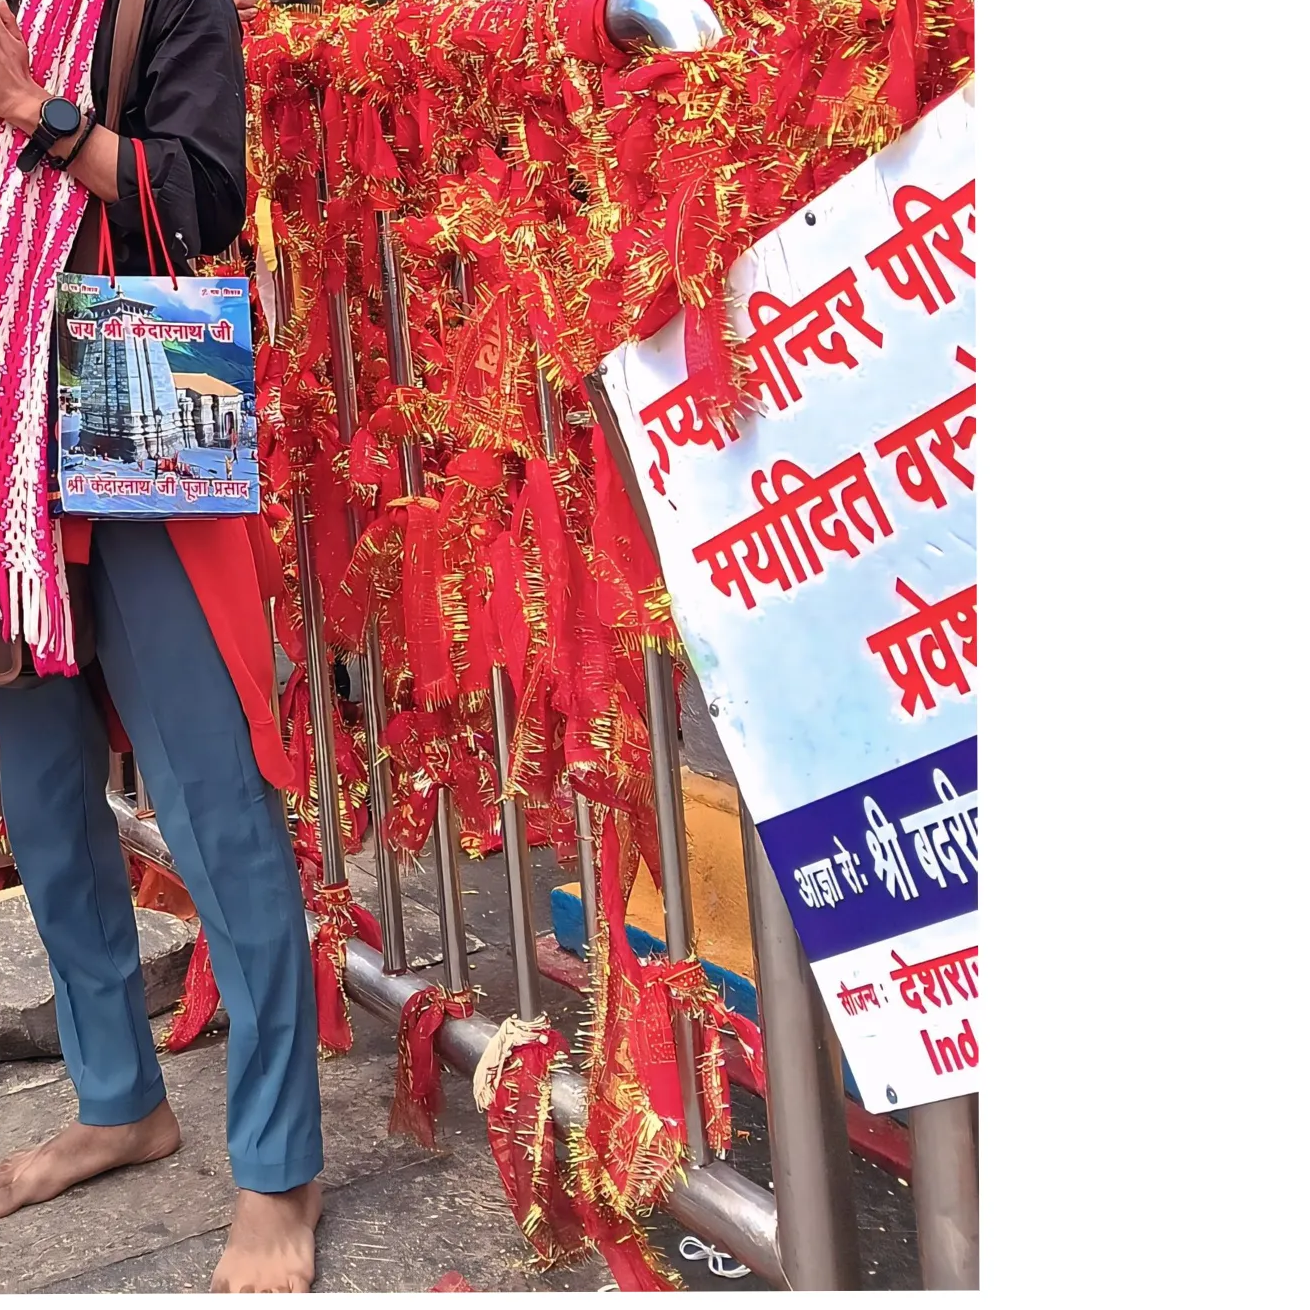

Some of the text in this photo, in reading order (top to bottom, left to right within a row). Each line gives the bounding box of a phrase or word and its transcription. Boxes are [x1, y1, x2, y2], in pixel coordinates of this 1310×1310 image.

[865, 178, 976, 316] परि
[69, 317, 233, 342] जय श्री केदारनाथ जी
[67, 476, 250, 501] श्री केदारनाथ जी पूजा प्रसाद
[693, 453, 894, 610] मर्यादित
[793, 857, 845, 908] आज्ञा
[863, 795, 920, 901] श्री
[899, 768, 979, 889] बदरी
[889, 949, 979, 1014] देशरा
